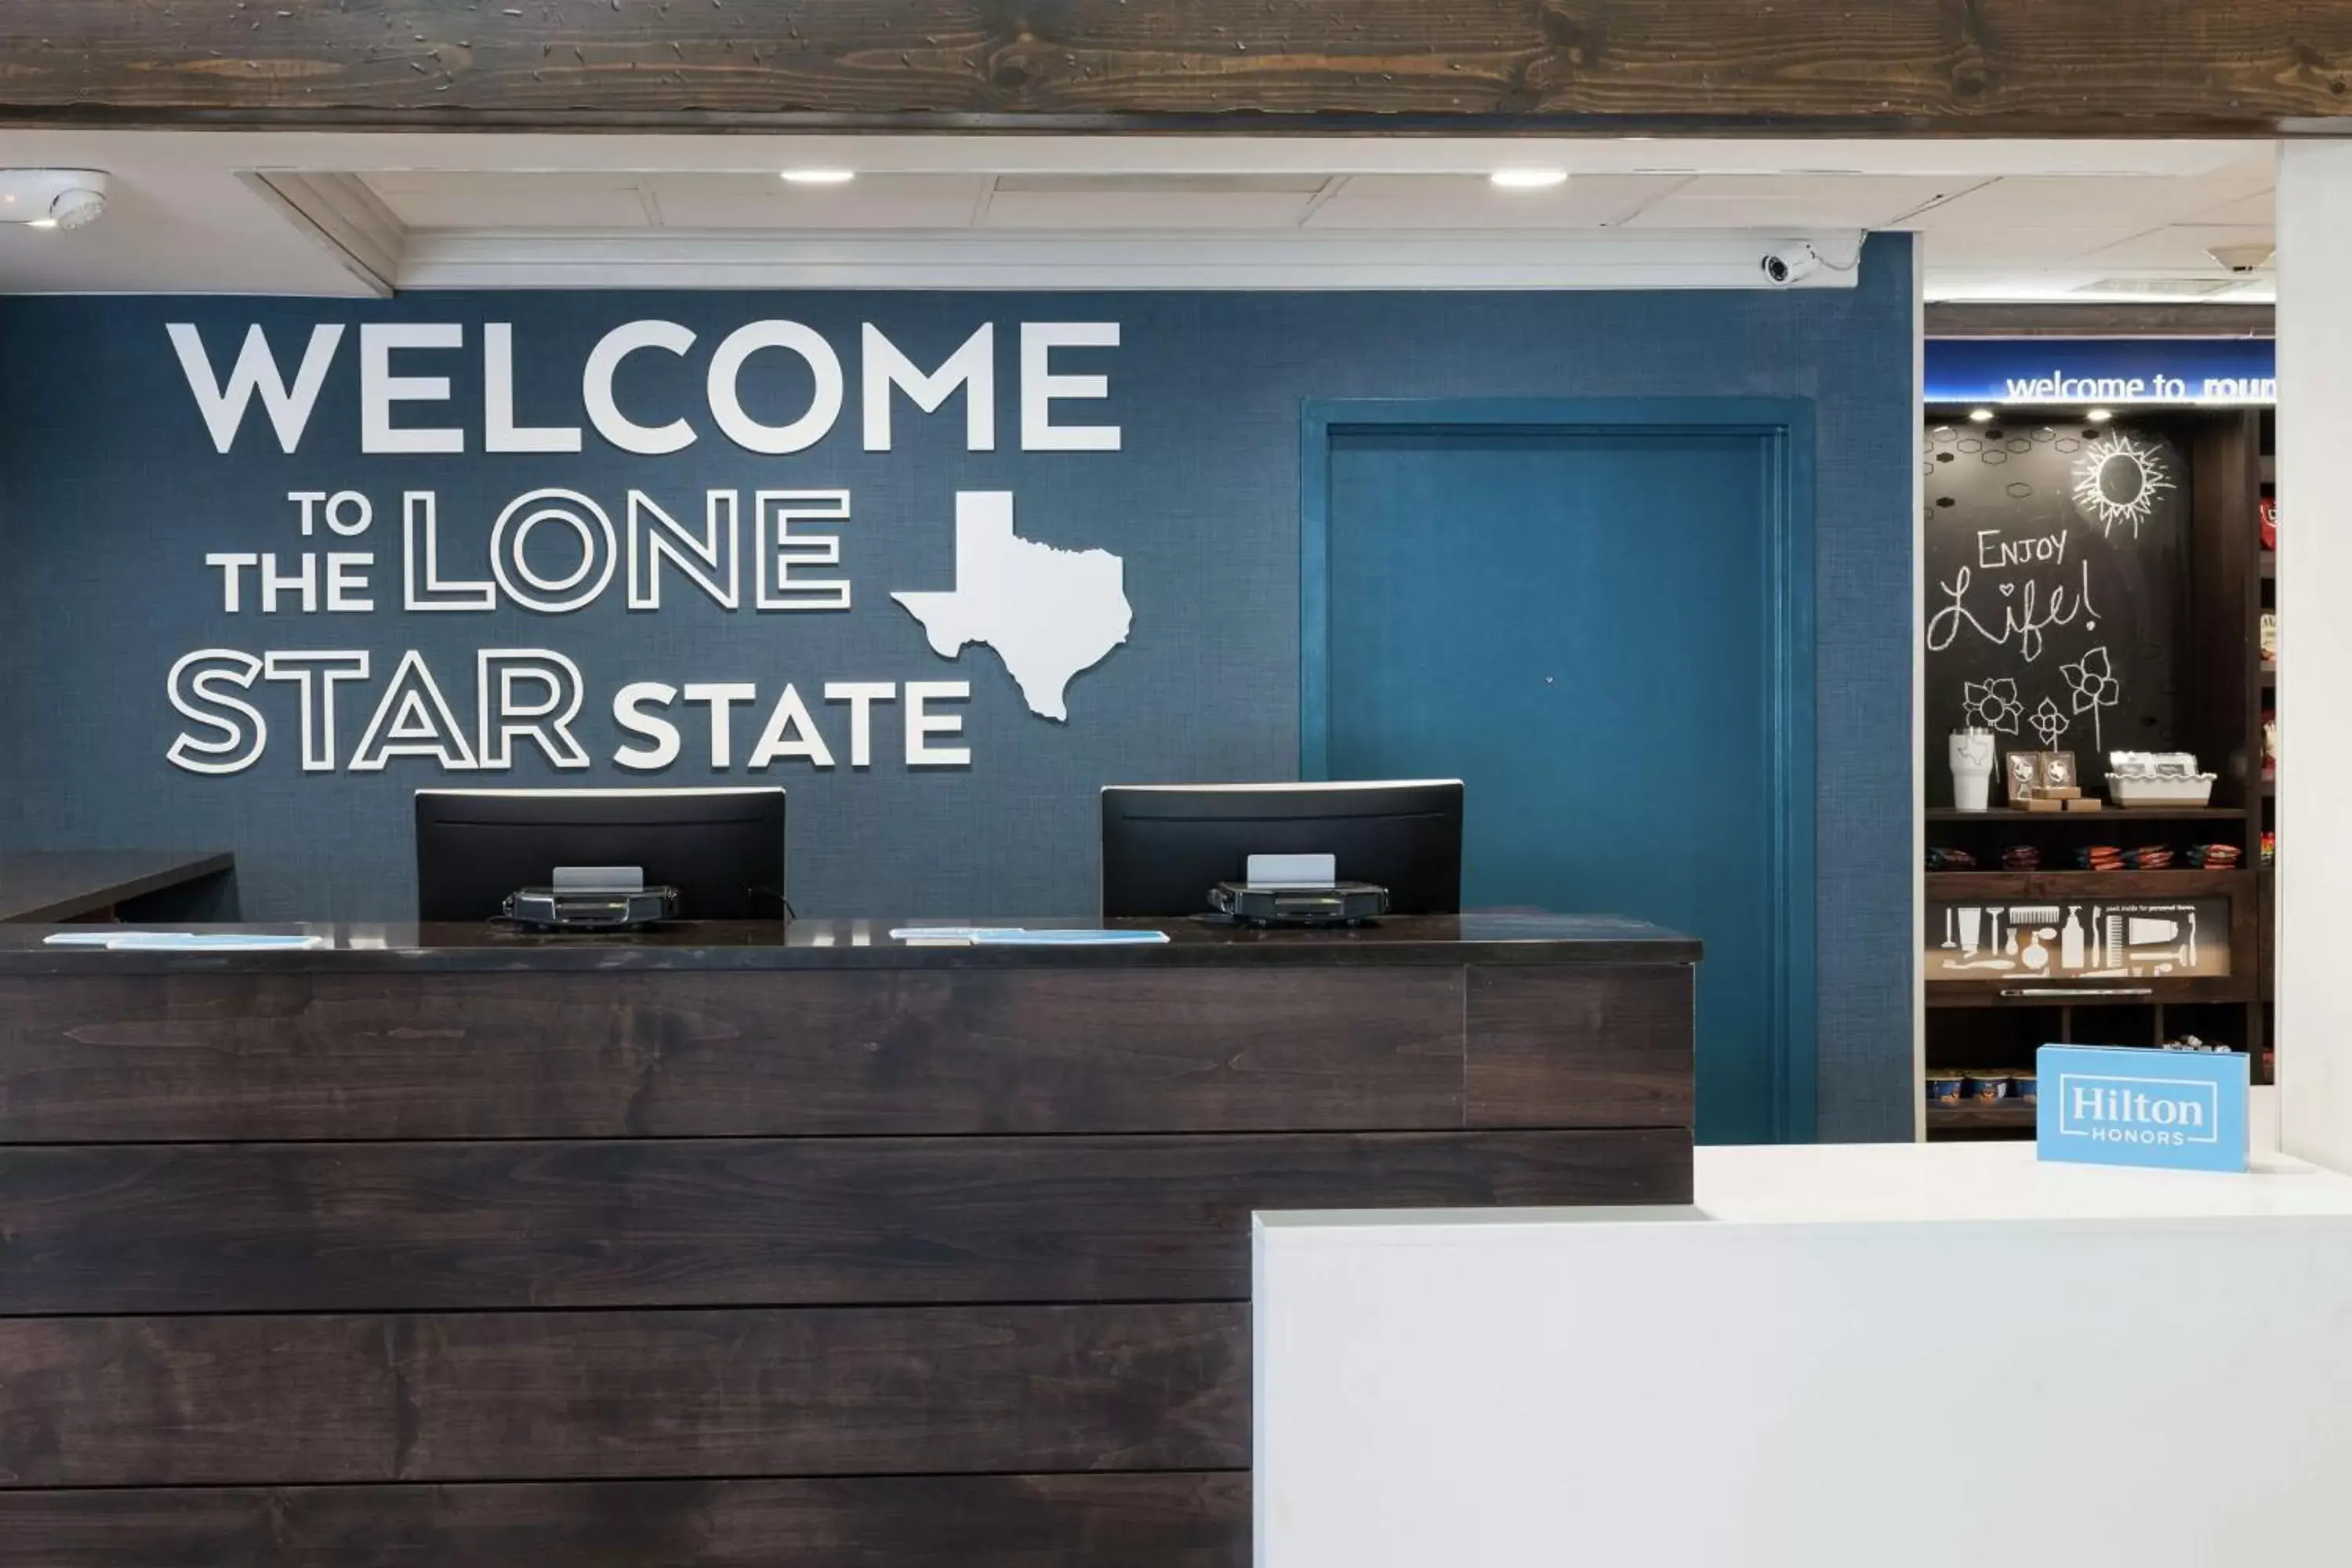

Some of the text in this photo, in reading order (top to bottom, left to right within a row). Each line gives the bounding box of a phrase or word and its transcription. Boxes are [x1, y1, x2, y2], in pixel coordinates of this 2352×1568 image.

[166, 320, 1121, 454] WELCOME
[2006, 370, 2144, 398] welcome
[2153, 374, 2185, 398] to
[289, 491, 372, 535] TO
[206, 488, 851, 612] THE LONE
[1977, 529, 2067, 568] ENJOY
[1927, 559, 2102, 662] Life!
[166, 648, 971, 773] STAR STATE
[2074, 1087, 2203, 1127] Hilton
[2092, 1127, 2184, 1146] HONORS
